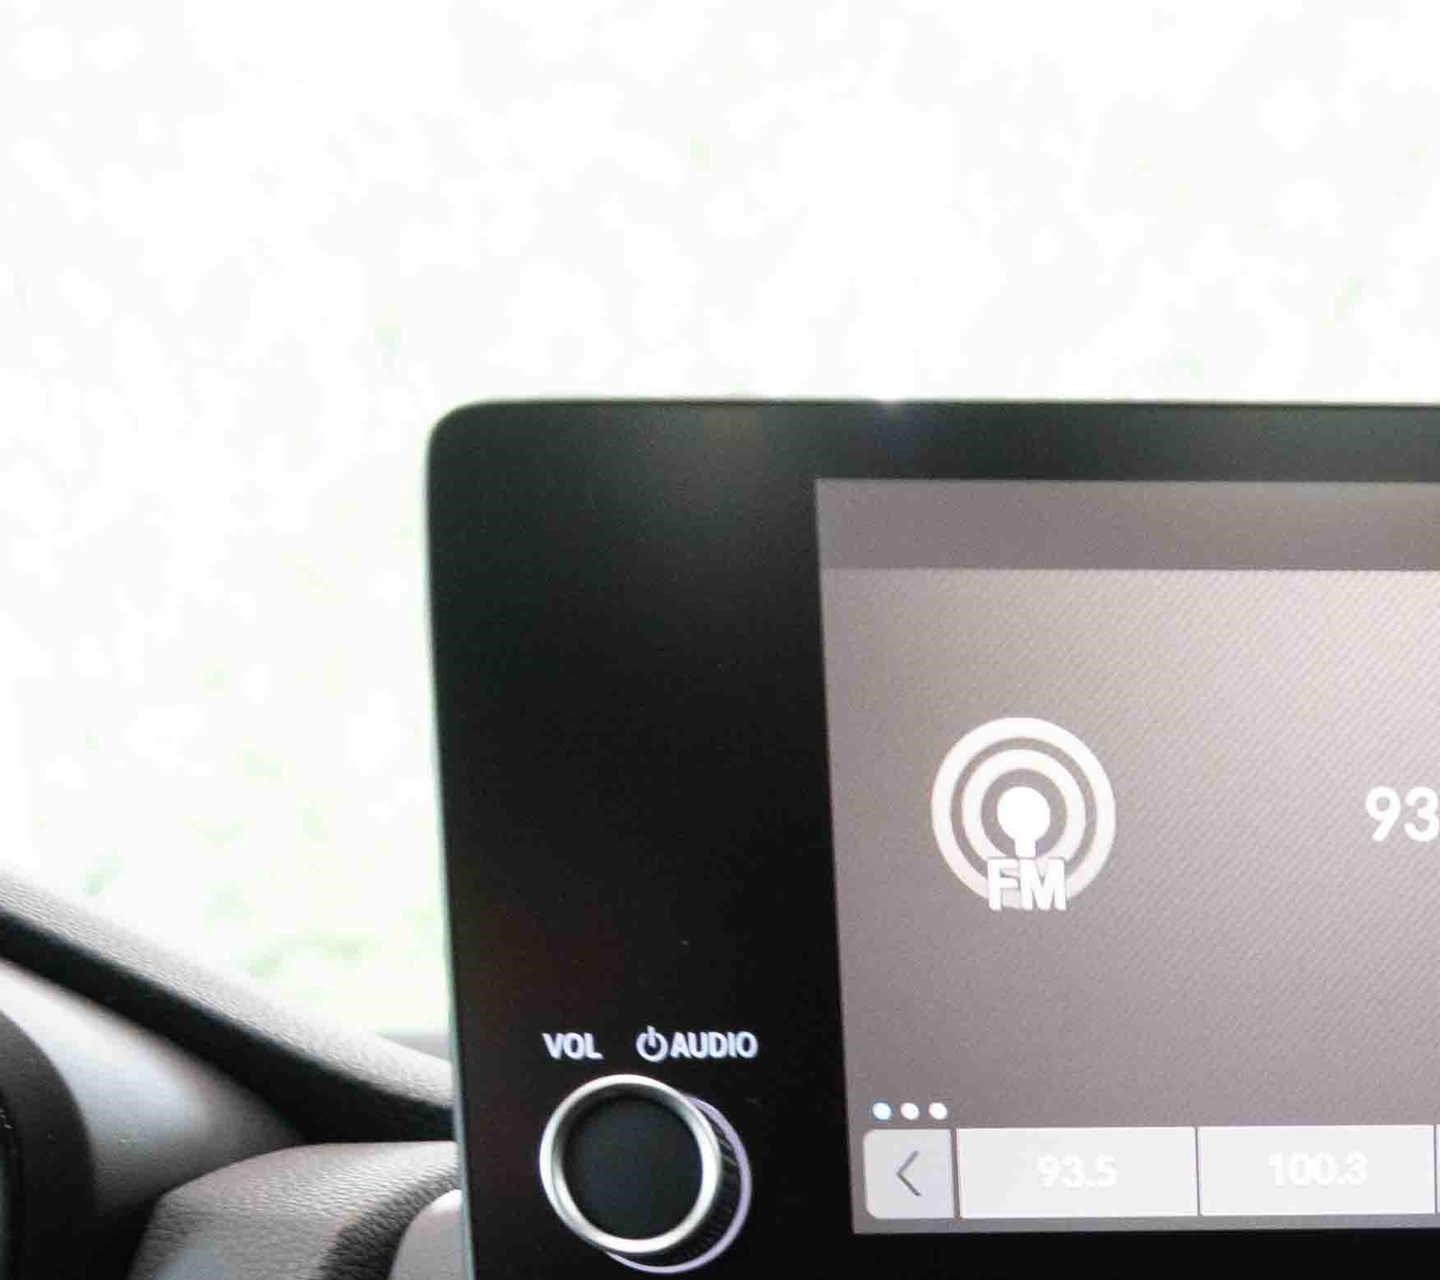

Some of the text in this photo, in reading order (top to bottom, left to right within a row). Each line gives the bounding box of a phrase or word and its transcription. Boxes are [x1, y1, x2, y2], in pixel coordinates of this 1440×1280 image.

[987, 857, 1067, 912] FM
[543, 1033, 603, 1060] VOL
[670, 1031, 759, 1059] AUDIO
[1036, 1152, 1118, 1190] 93.5
[1266, 1150, 1369, 1188] 100.3
